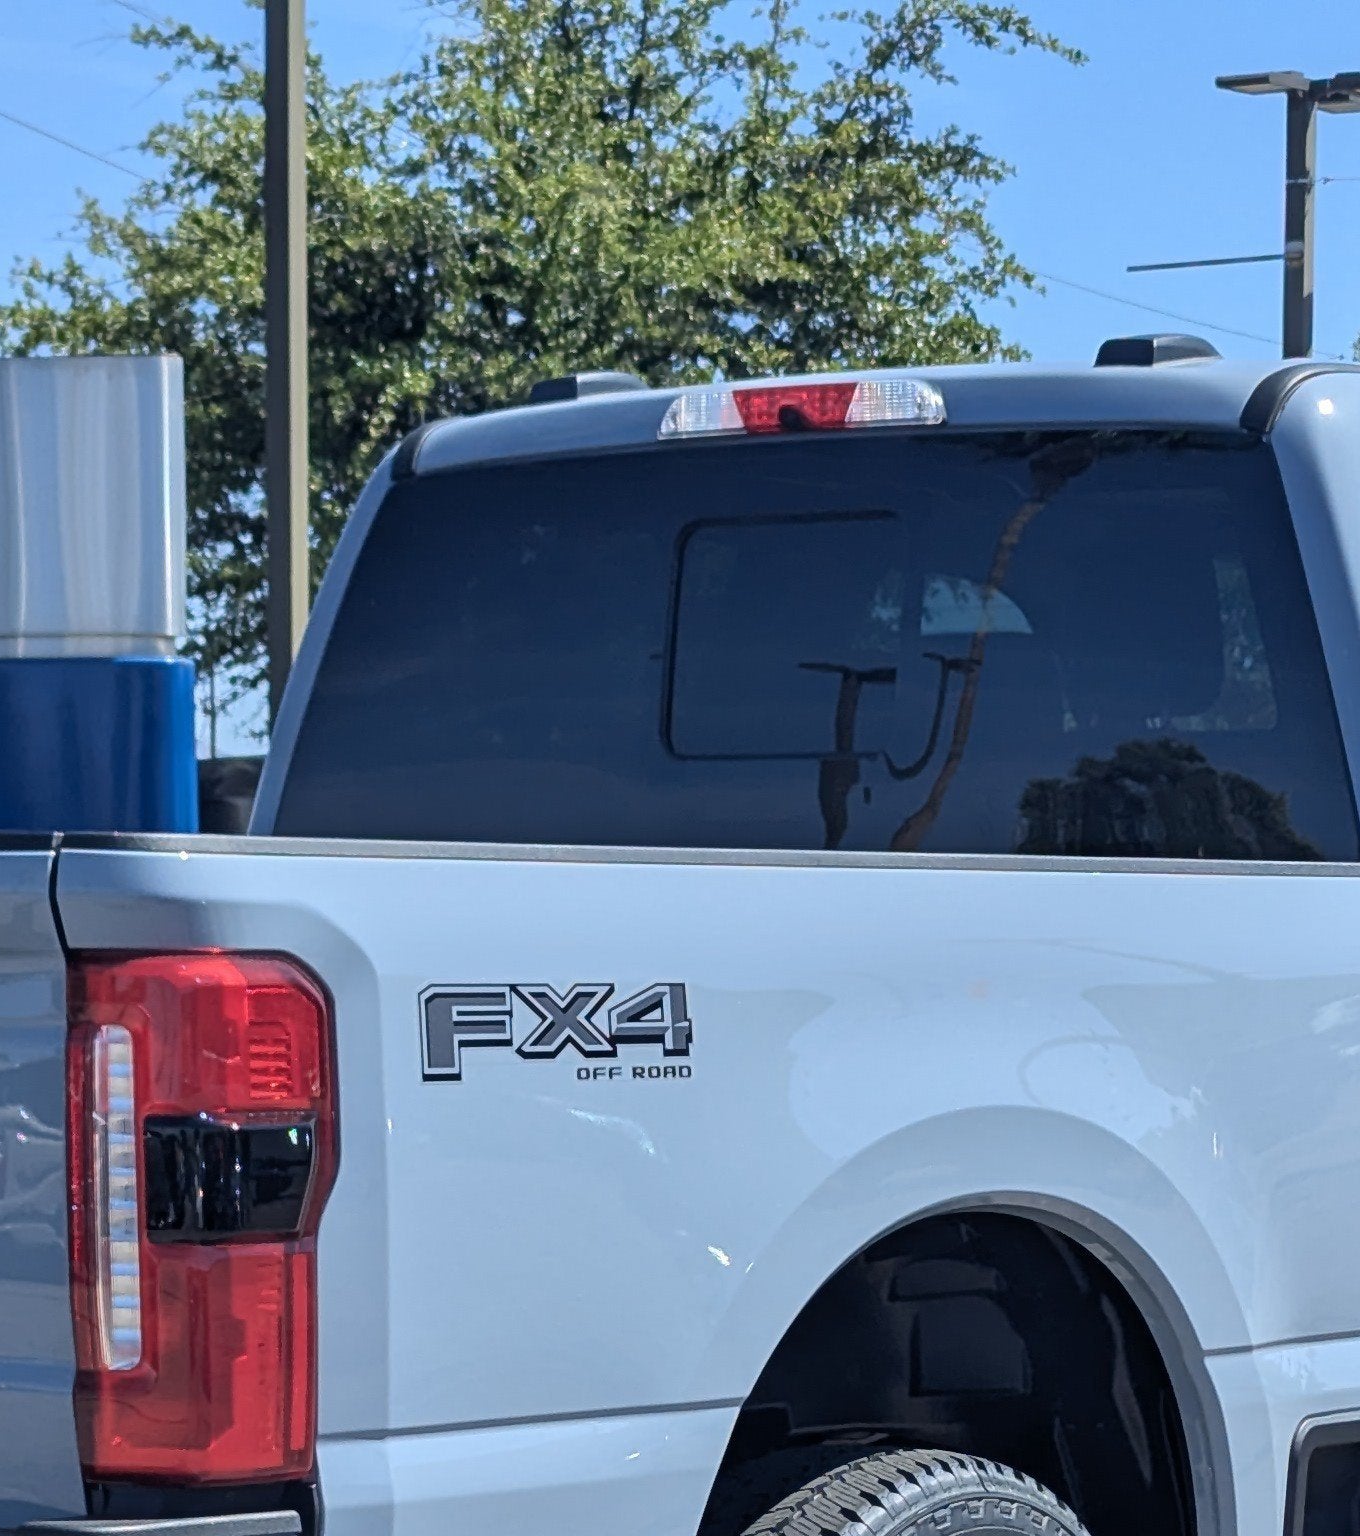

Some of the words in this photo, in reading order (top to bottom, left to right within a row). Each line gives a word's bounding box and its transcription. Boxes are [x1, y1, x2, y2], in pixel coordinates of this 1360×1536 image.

[418, 982, 692, 1081] FX4
[577, 1066, 622, 1080] OFF
[632, 1065, 692, 1079] ROAD
